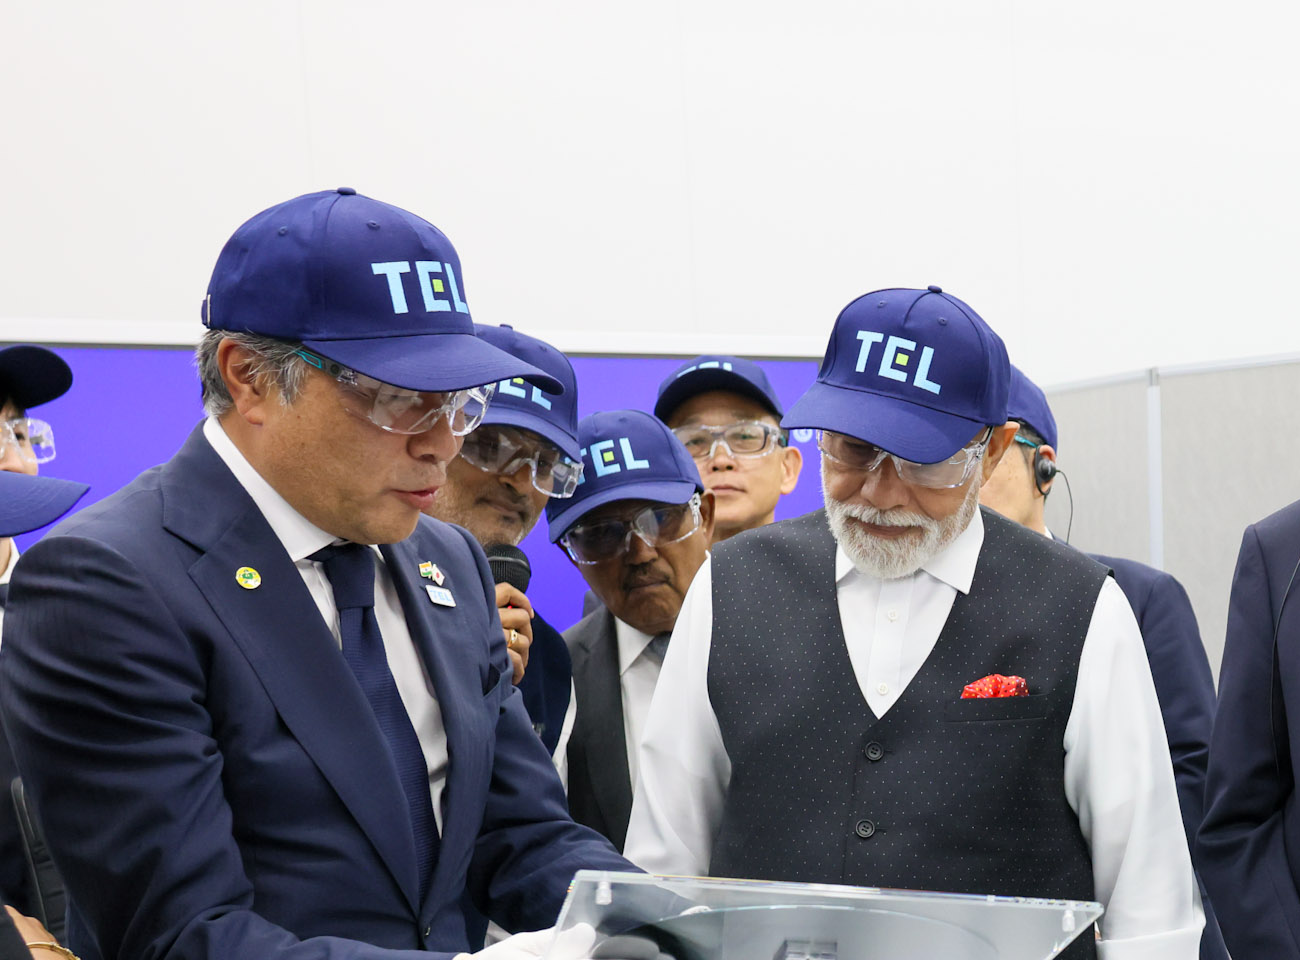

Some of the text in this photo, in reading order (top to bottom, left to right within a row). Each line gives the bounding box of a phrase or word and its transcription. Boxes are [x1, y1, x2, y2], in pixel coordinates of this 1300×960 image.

[371, 261, 469, 314] TEL
[855, 330, 941, 395] TEL
[483, 378, 552, 411] EL
[430, 590, 452, 601] TEL
